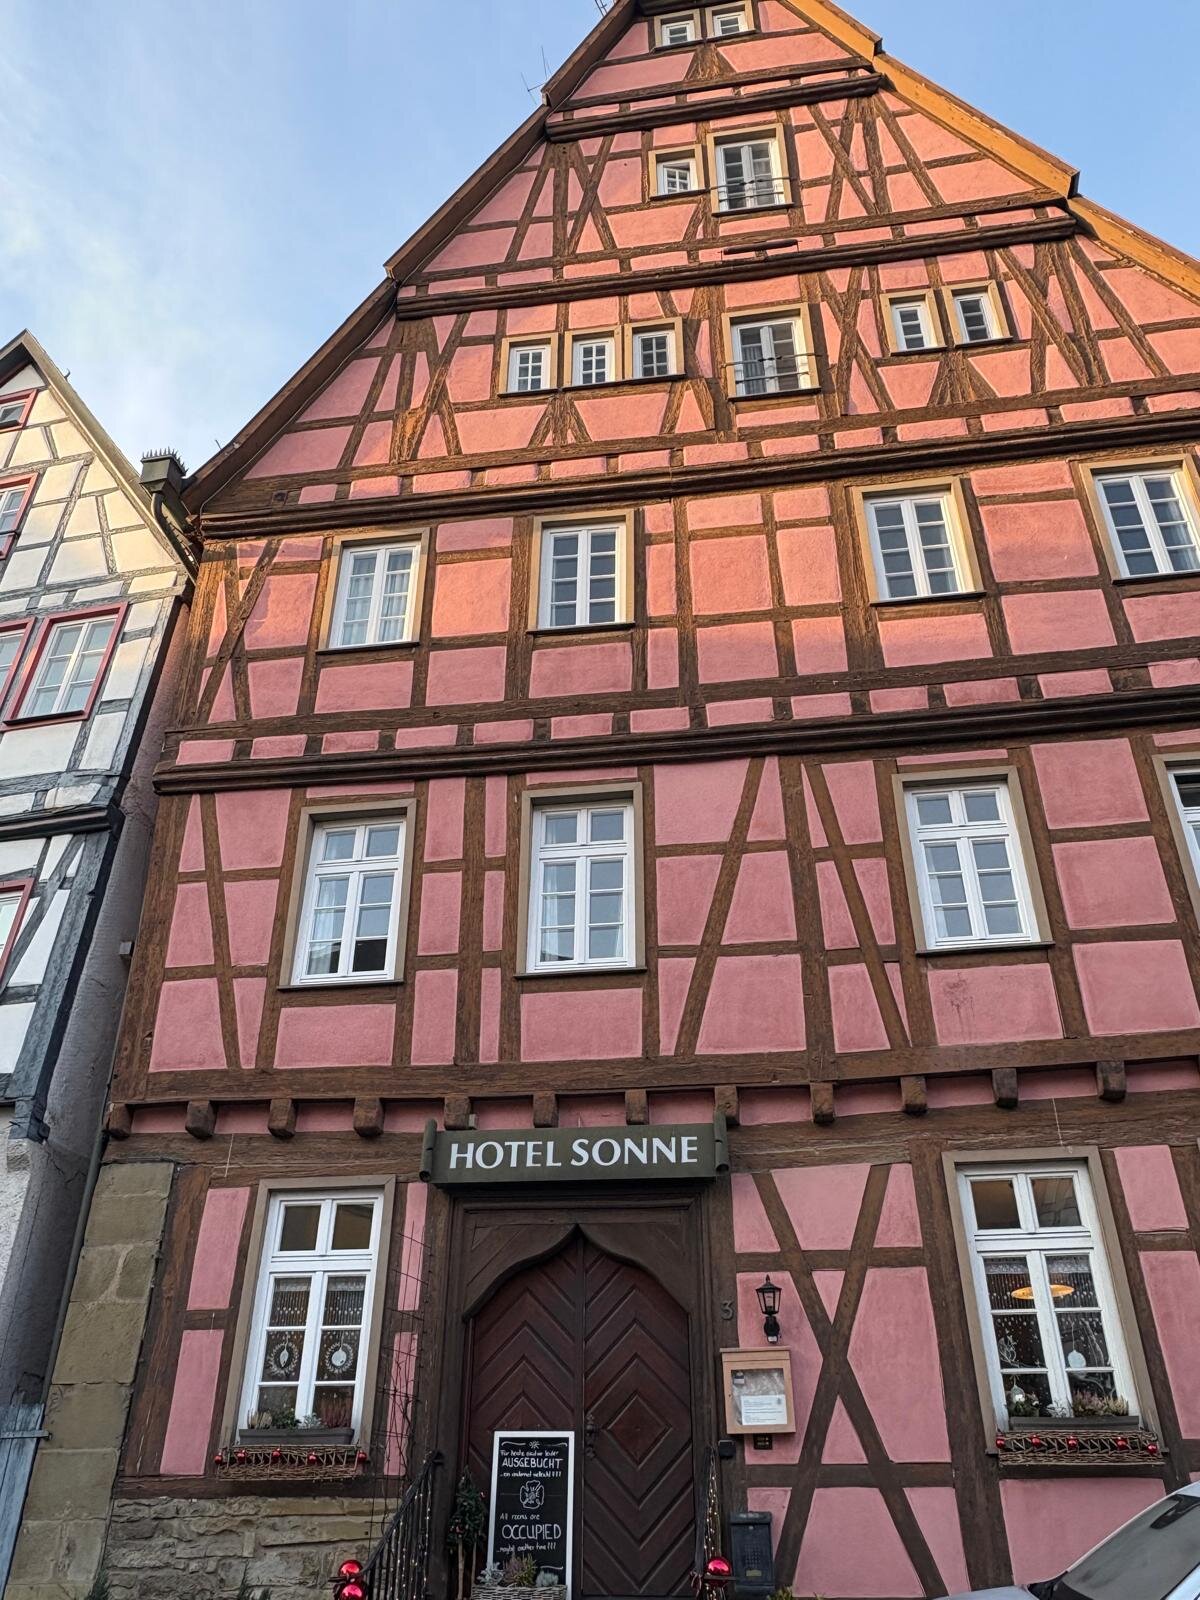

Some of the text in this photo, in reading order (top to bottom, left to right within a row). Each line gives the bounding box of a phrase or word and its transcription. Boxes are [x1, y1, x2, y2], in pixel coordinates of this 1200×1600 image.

[449, 1136, 698, 1169] HOTEL SONNE
[721, 1300, 734, 1320] 3
[502, 1457, 564, 1469] AUSGEBUCHT
[502, 1524, 562, 1540] OCCUPIED
